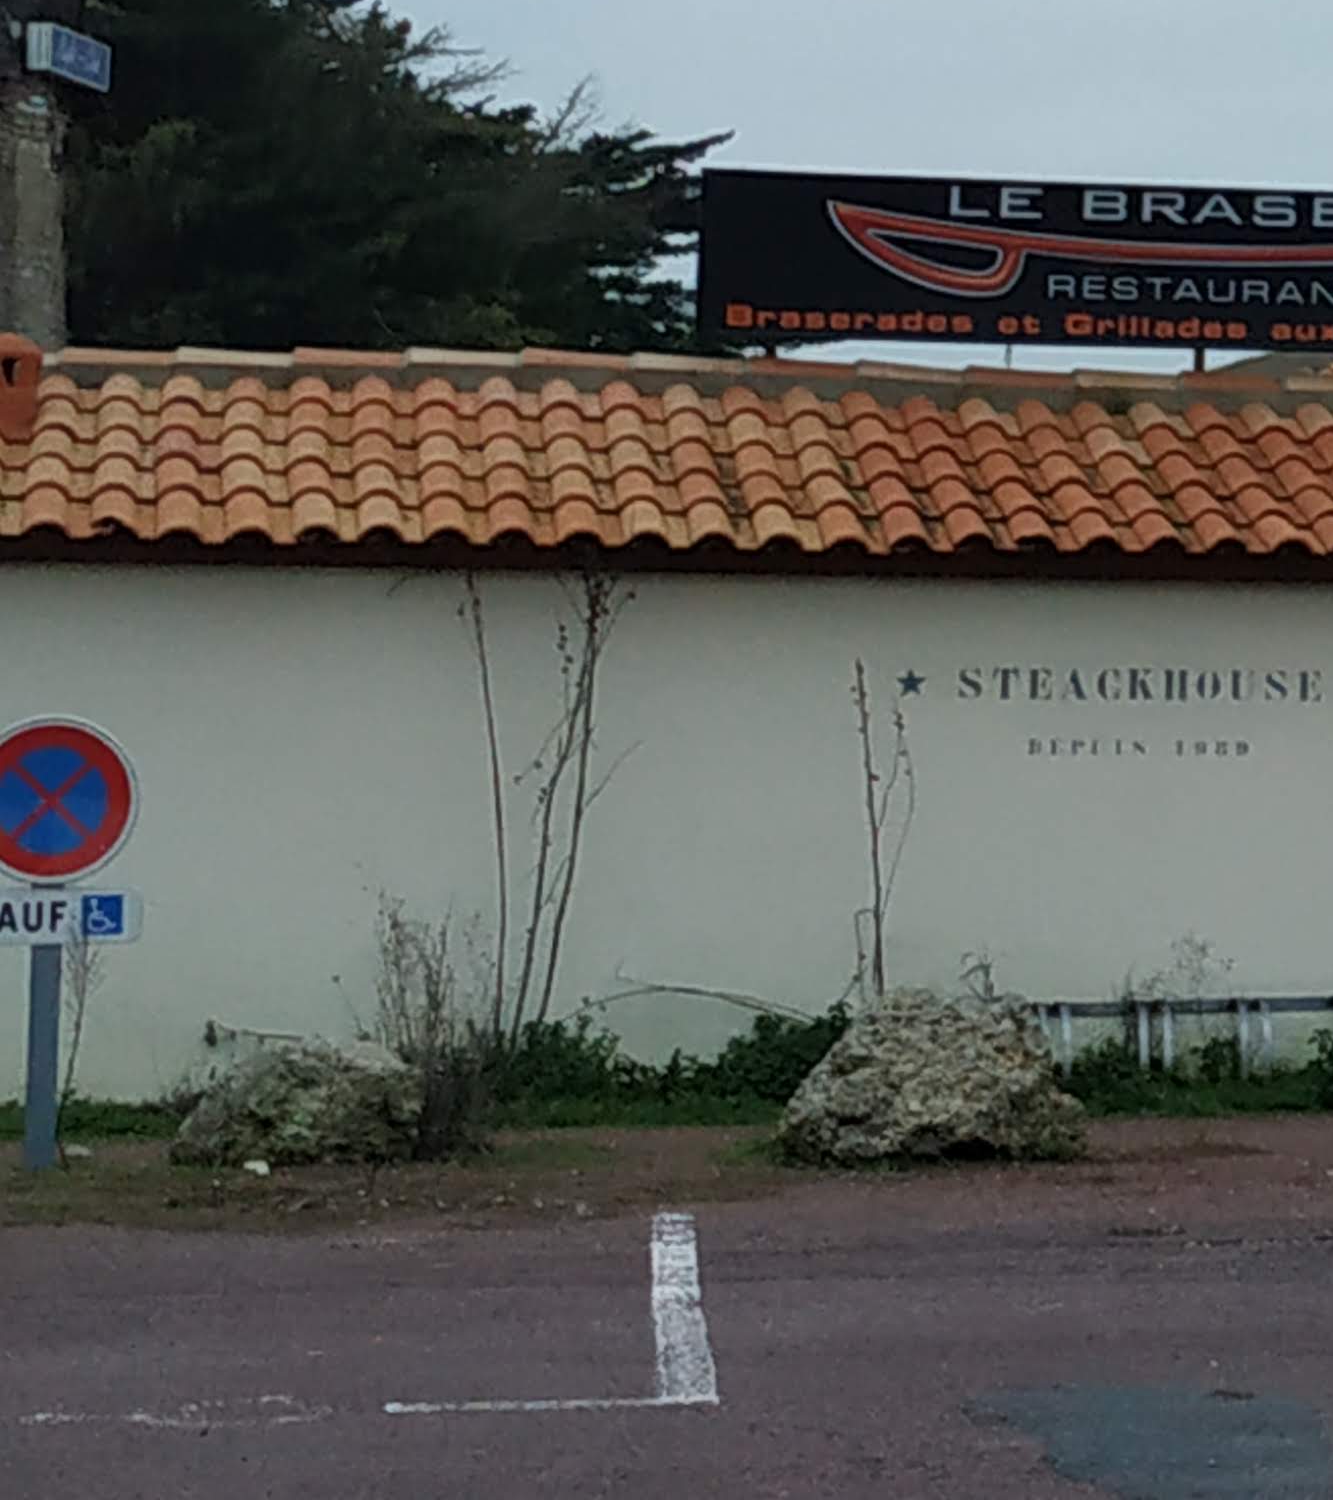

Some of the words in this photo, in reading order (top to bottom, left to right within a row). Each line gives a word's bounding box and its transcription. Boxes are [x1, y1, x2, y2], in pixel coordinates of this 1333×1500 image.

[948, 185, 1044, 220] LE
[725, 303, 974, 334] Braserades
[997, 315, 1041, 336] et
[1064, 312, 1248, 340] Grillades
[957, 665, 1324, 703] STEACKHOUSE
